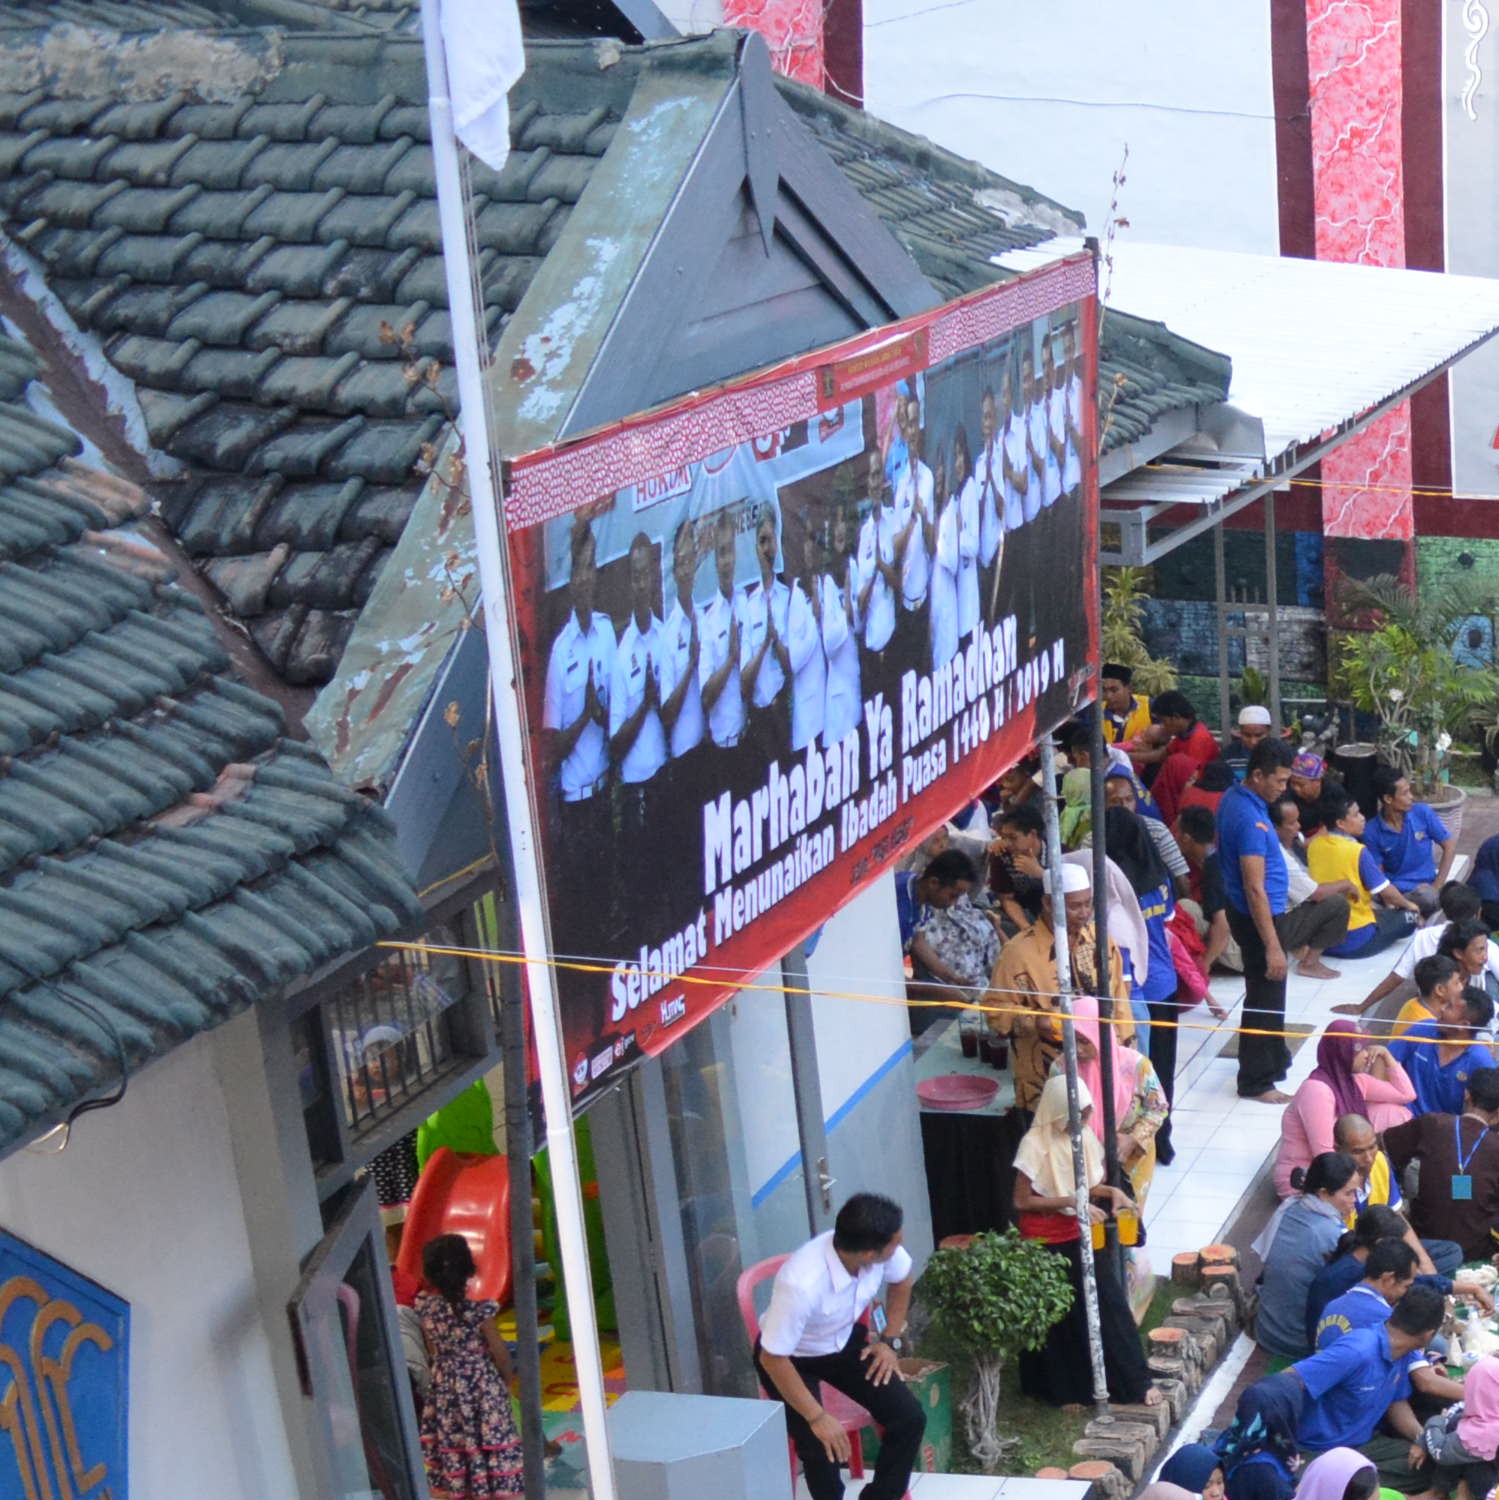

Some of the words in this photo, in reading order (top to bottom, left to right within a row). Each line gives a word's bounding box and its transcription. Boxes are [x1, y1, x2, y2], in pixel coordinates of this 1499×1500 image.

[611, 908, 707, 1022] Selamat
[714, 824, 835, 947] Menunaikan
[841, 775, 897, 853] Ibadah
[902, 737, 947, 804] Puasa
[952, 697, 990, 765] 1440
[994, 685, 1005, 731] H
[1017, 650, 1050, 712] 2019
[1053, 637, 1065, 685] M
[704, 729, 859, 895] Marhaban
[864, 692, 893, 781] Ya
[902, 614, 1018, 752] Ramadhan
